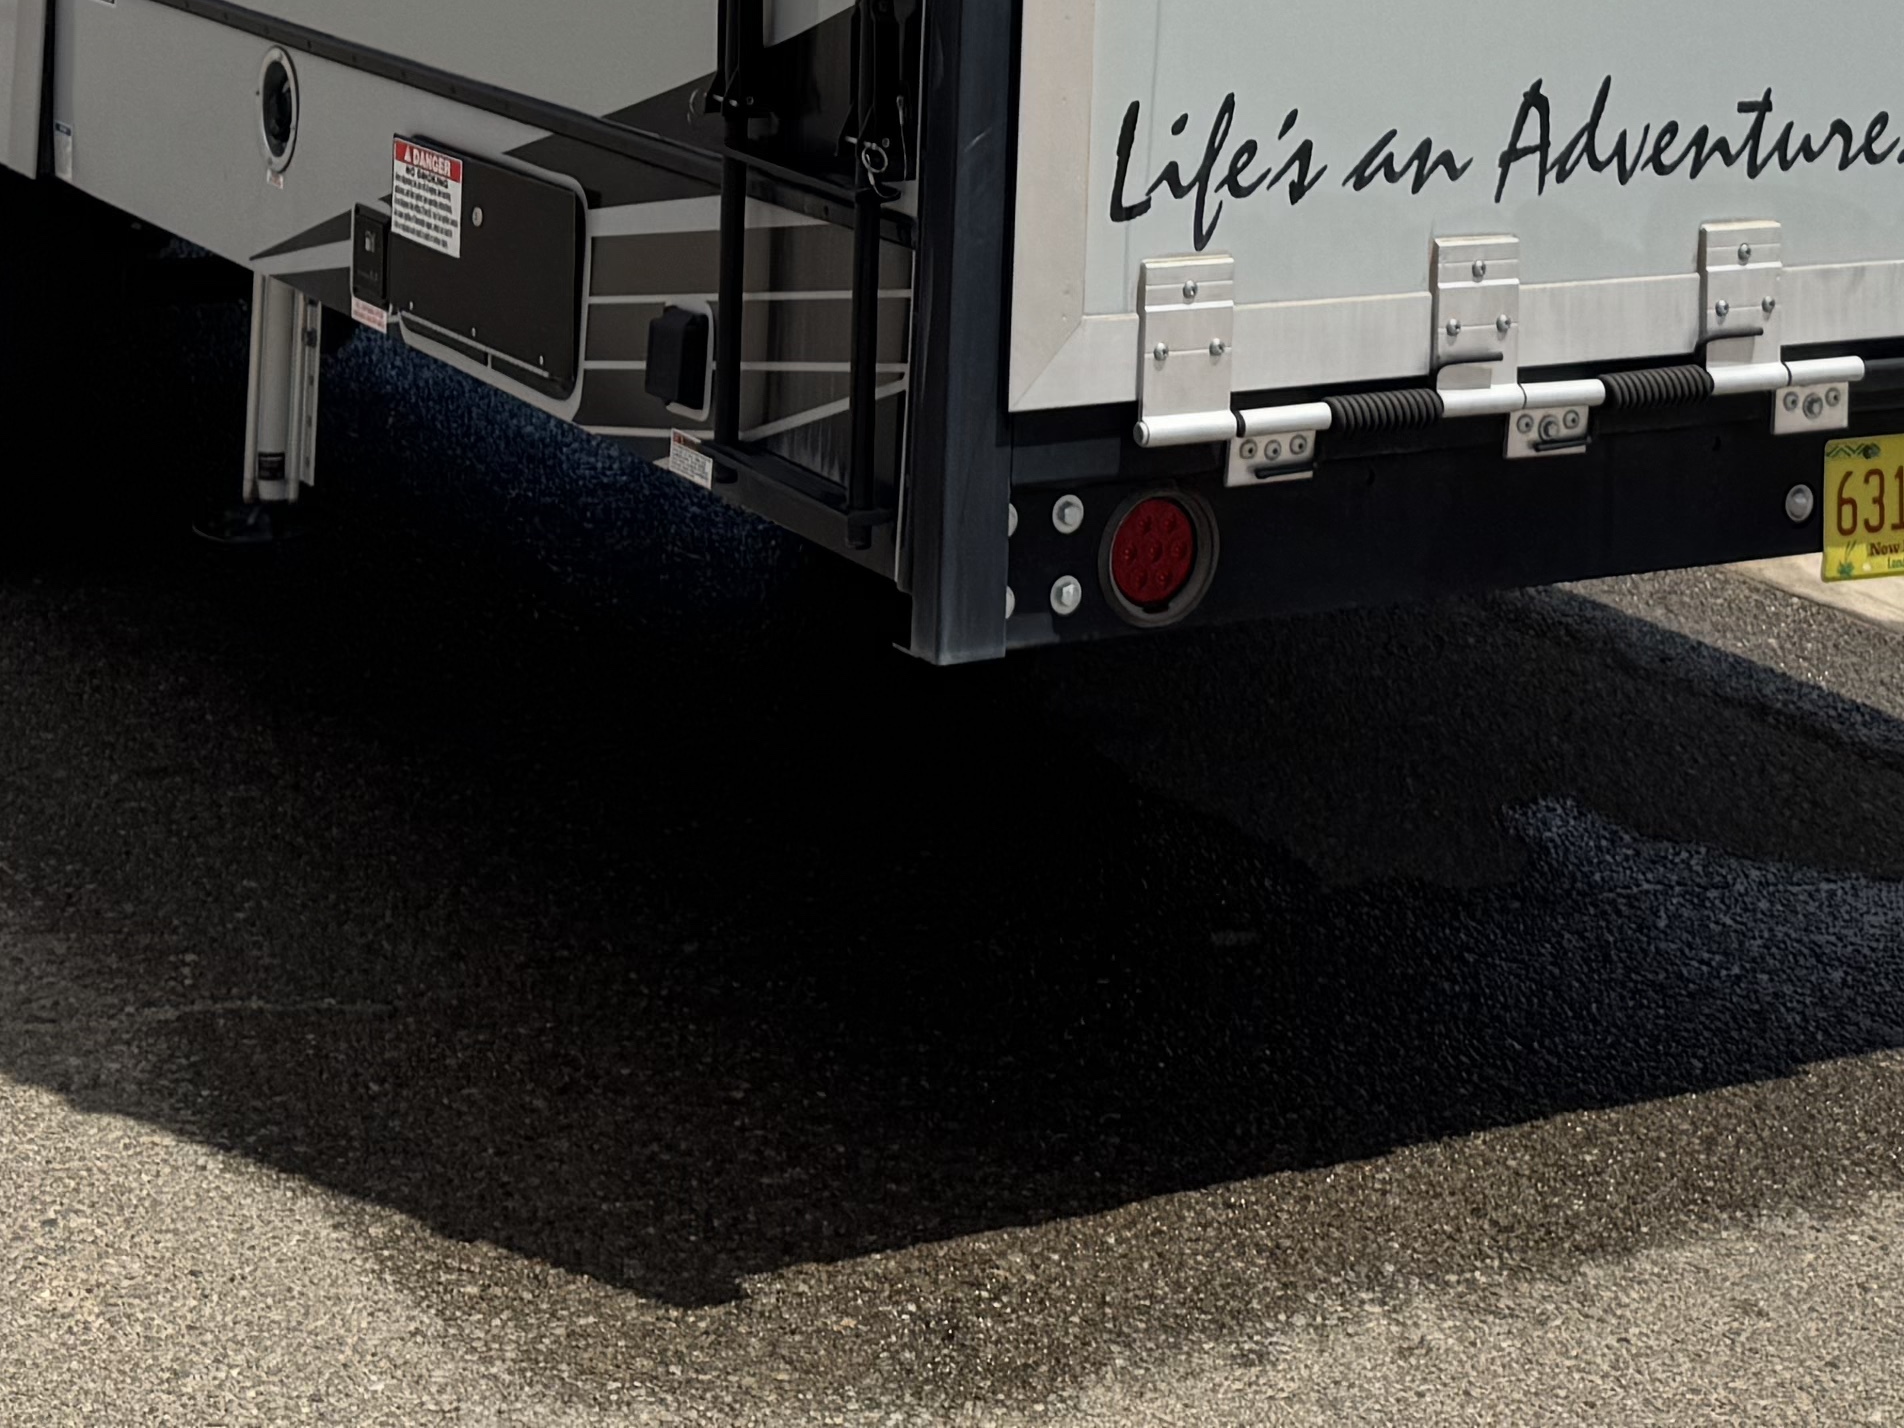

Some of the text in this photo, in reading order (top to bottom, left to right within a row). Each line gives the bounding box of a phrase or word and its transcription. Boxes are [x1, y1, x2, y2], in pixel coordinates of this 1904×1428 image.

[412, 148, 451, 178] DANGER
[1109, 93, 1327, 252] Life's
[1344, 128, 1473, 194] an
[1869, 540, 1900, 558] New
